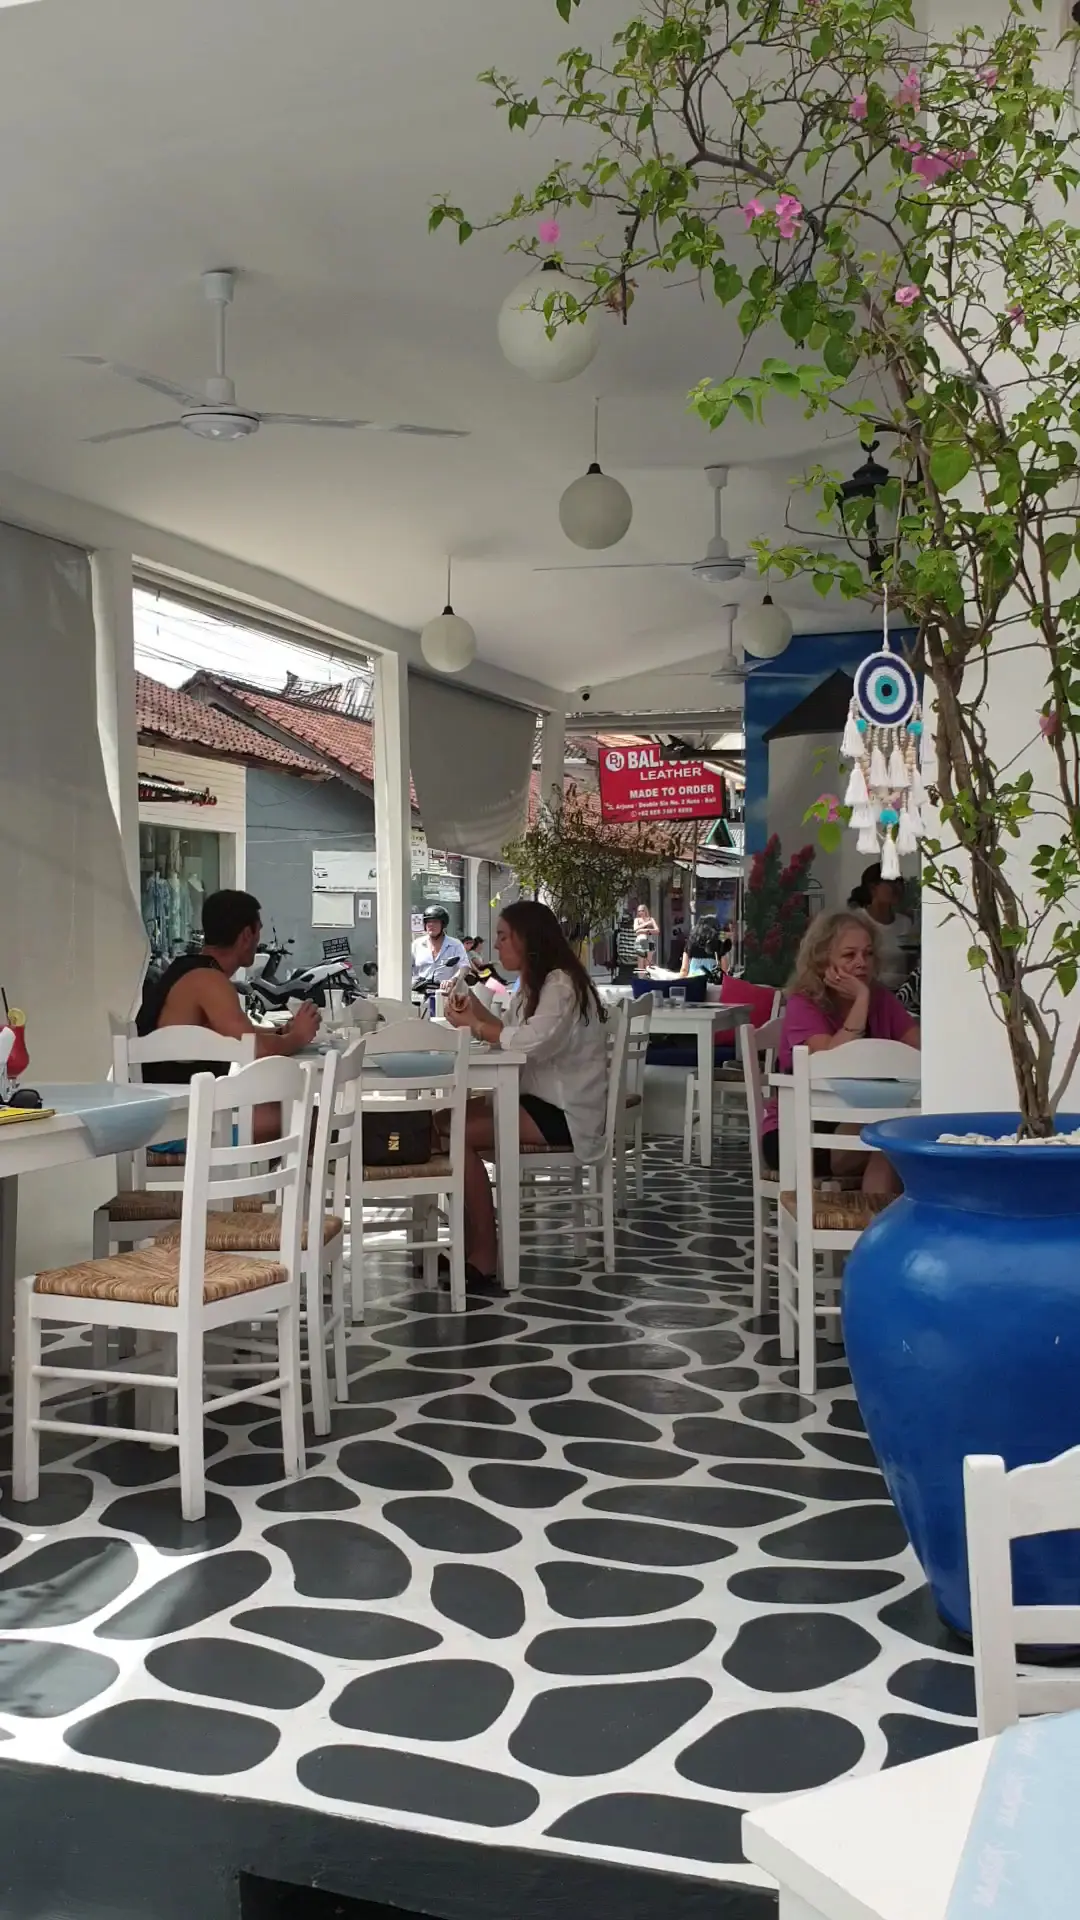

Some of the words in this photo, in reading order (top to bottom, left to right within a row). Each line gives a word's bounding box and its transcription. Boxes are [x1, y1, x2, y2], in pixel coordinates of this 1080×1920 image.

[640, 767, 702, 781] LEATHER
[629, 788, 659, 799] MADE
[662, 786, 675, 796] TO
[678, 784, 715, 796] ORDER
